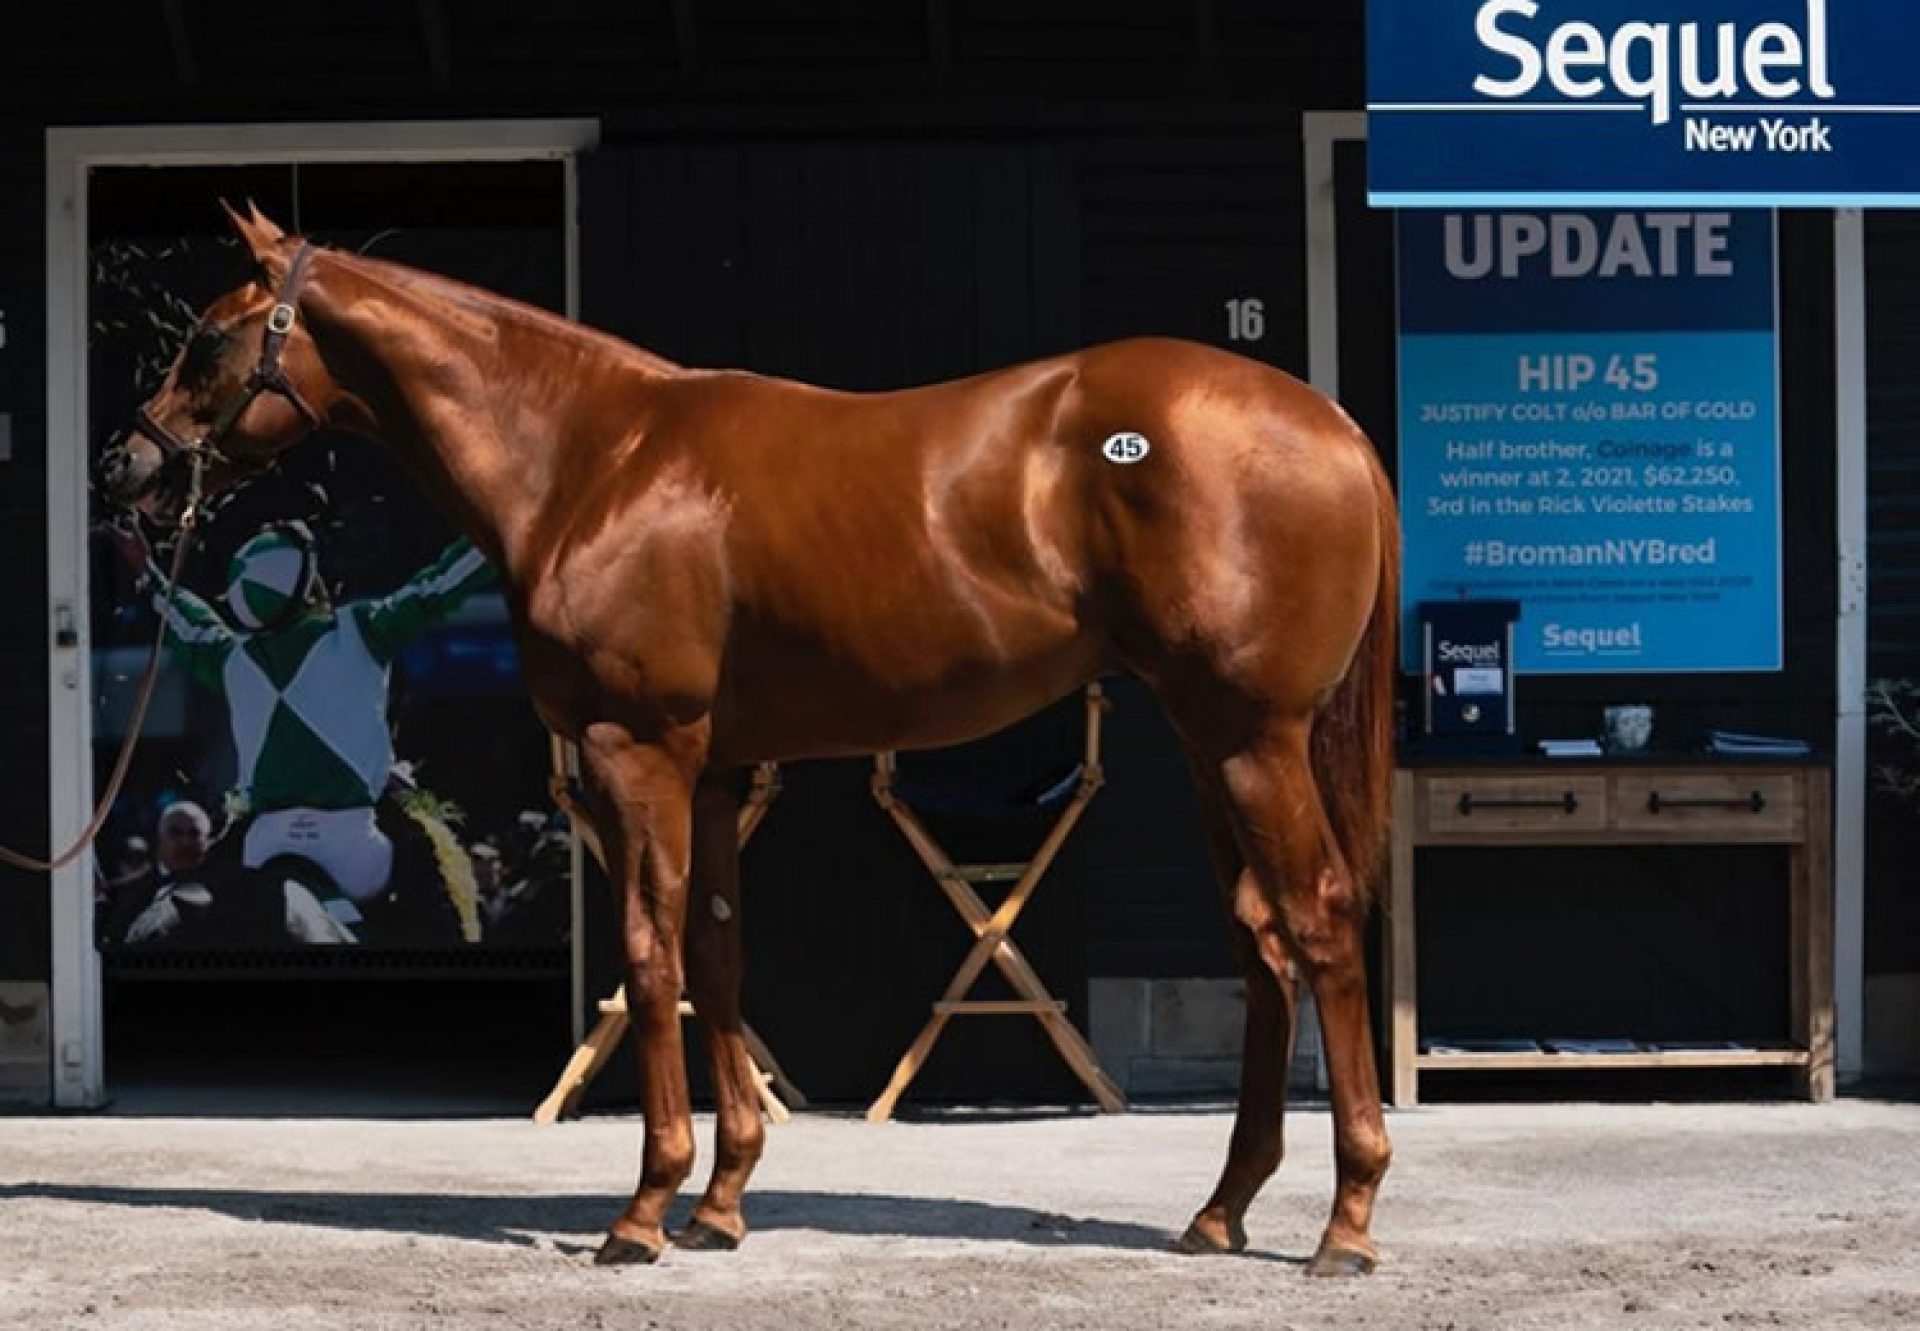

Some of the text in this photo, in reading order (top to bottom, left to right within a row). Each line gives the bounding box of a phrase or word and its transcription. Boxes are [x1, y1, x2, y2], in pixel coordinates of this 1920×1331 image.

[1473, 0, 1836, 124] Sequel
[1684, 118, 1832, 151] New York
[1444, 212, 1734, 279] UPDATE
[1225, 298, 1265, 340] 16
[1518, 354, 1658, 392] HIP 45
[1420, 403, 1506, 422] JUSTIFY
[1512, 402, 1567, 421] COLT
[1610, 401, 1657, 420] BAR
[1661, 401, 1692, 420] OF
[1695, 400, 1757, 420] GOLD
[1110, 437, 1142, 457] 45
[1446, 439, 1494, 460] Half
[1597, 439, 1692, 462] Coinage
[1696, 437, 1716, 457] is
[1720, 441, 1734, 457] a
[1440, 466, 1524, 488] winner
[1527, 469, 1550, 487] at
[1427, 494, 1754, 515] 3rd in the Rick Violette Stakes
[1464, 538, 1716, 567] #BromanNYBred
[1543, 622, 1641, 651] Sequel
[1438, 640, 1500, 663] Sequel
